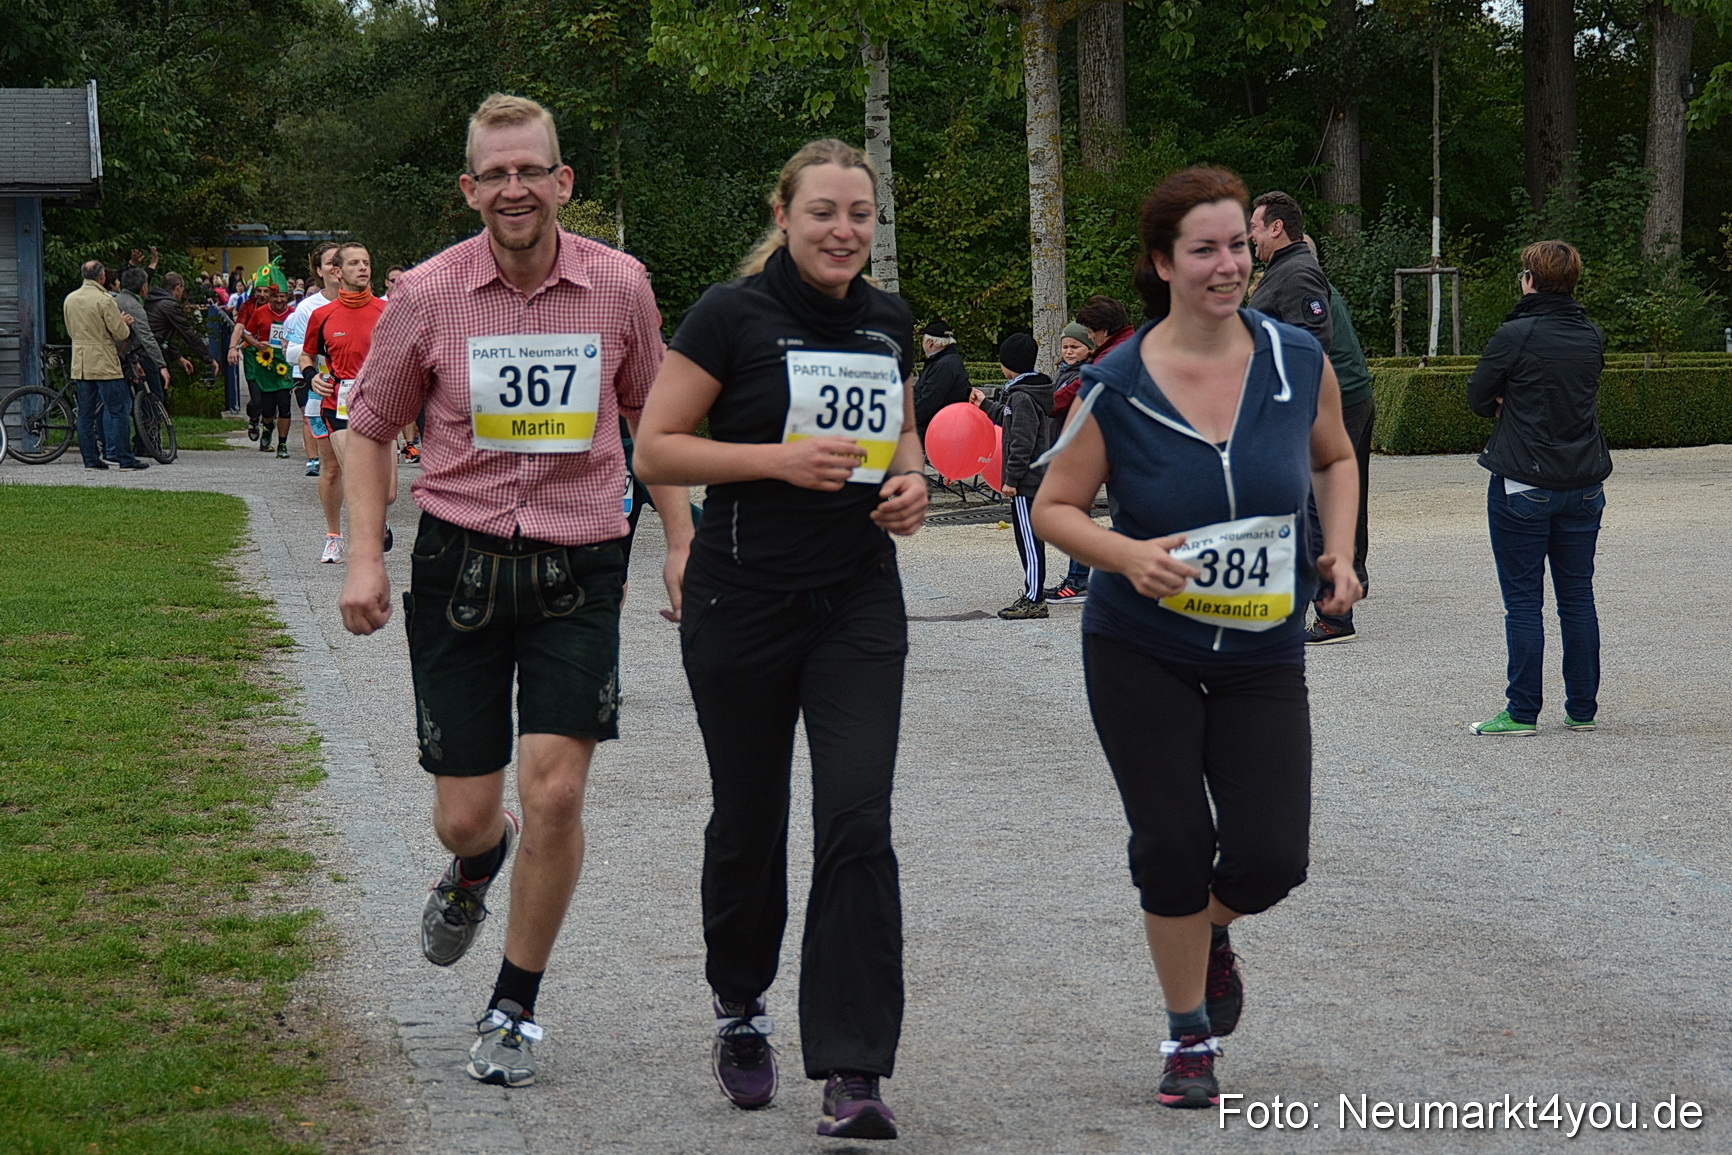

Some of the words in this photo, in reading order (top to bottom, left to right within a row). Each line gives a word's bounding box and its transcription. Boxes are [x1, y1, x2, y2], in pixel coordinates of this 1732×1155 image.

[472, 348, 516, 359] PARTL
[519, 347, 579, 358] Neumarkt
[792, 365, 835, 377] PARTL
[499, 364, 577, 407] 367
[816, 385, 886, 433] 385
[512, 419, 565, 436] Martin
[1220, 529, 1275, 541] Neumarkt
[1194, 547, 1269, 589] 384
[1184, 599, 1269, 617] Alexandra
